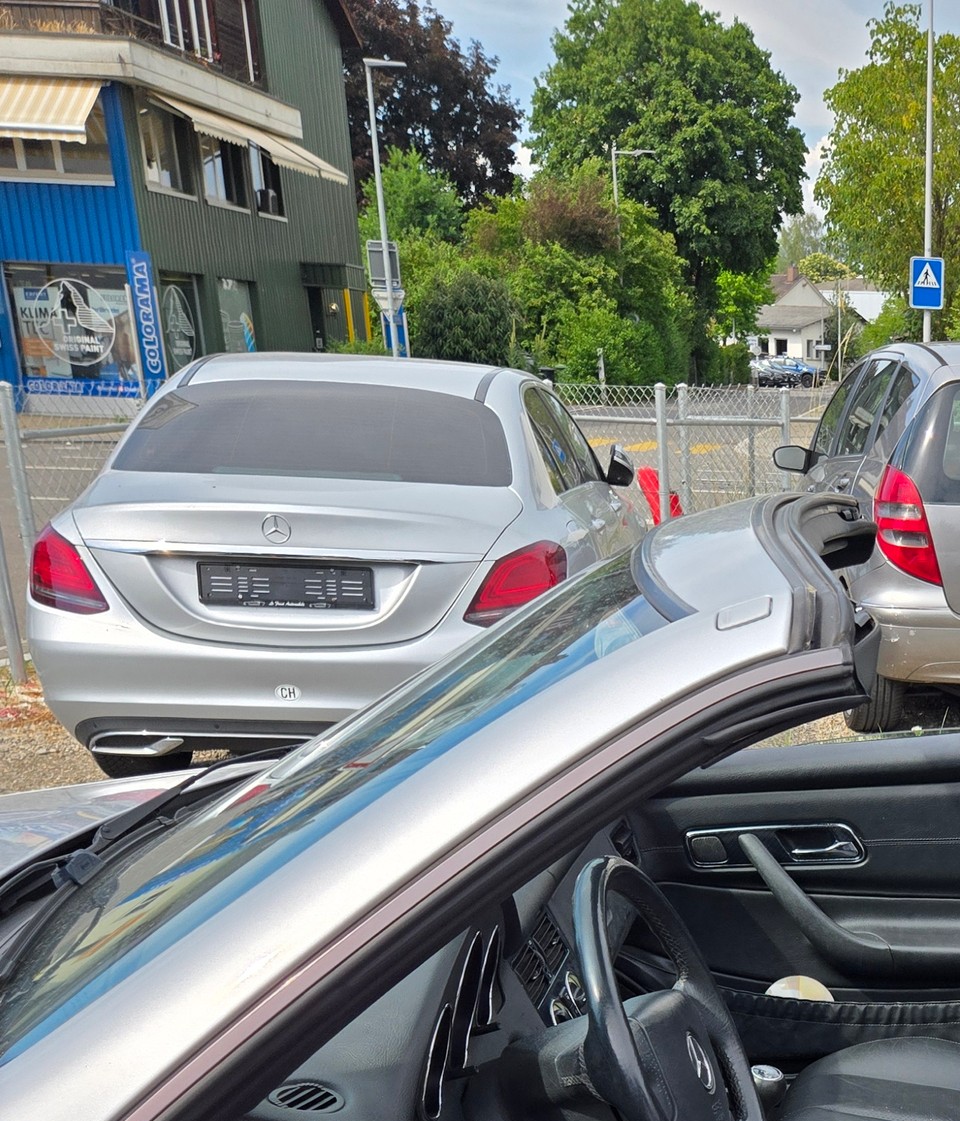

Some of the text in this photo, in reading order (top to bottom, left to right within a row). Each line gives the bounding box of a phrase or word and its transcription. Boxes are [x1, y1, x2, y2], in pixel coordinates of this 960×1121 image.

[20, 307, 57, 319] KLIMA
[133, 261, 162, 374] COLORAMA
[63, 335, 101, 345] ORIGINAL
[54, 343, 105, 354] SWISS PAINT
[280, 687, 296, 699] CH
